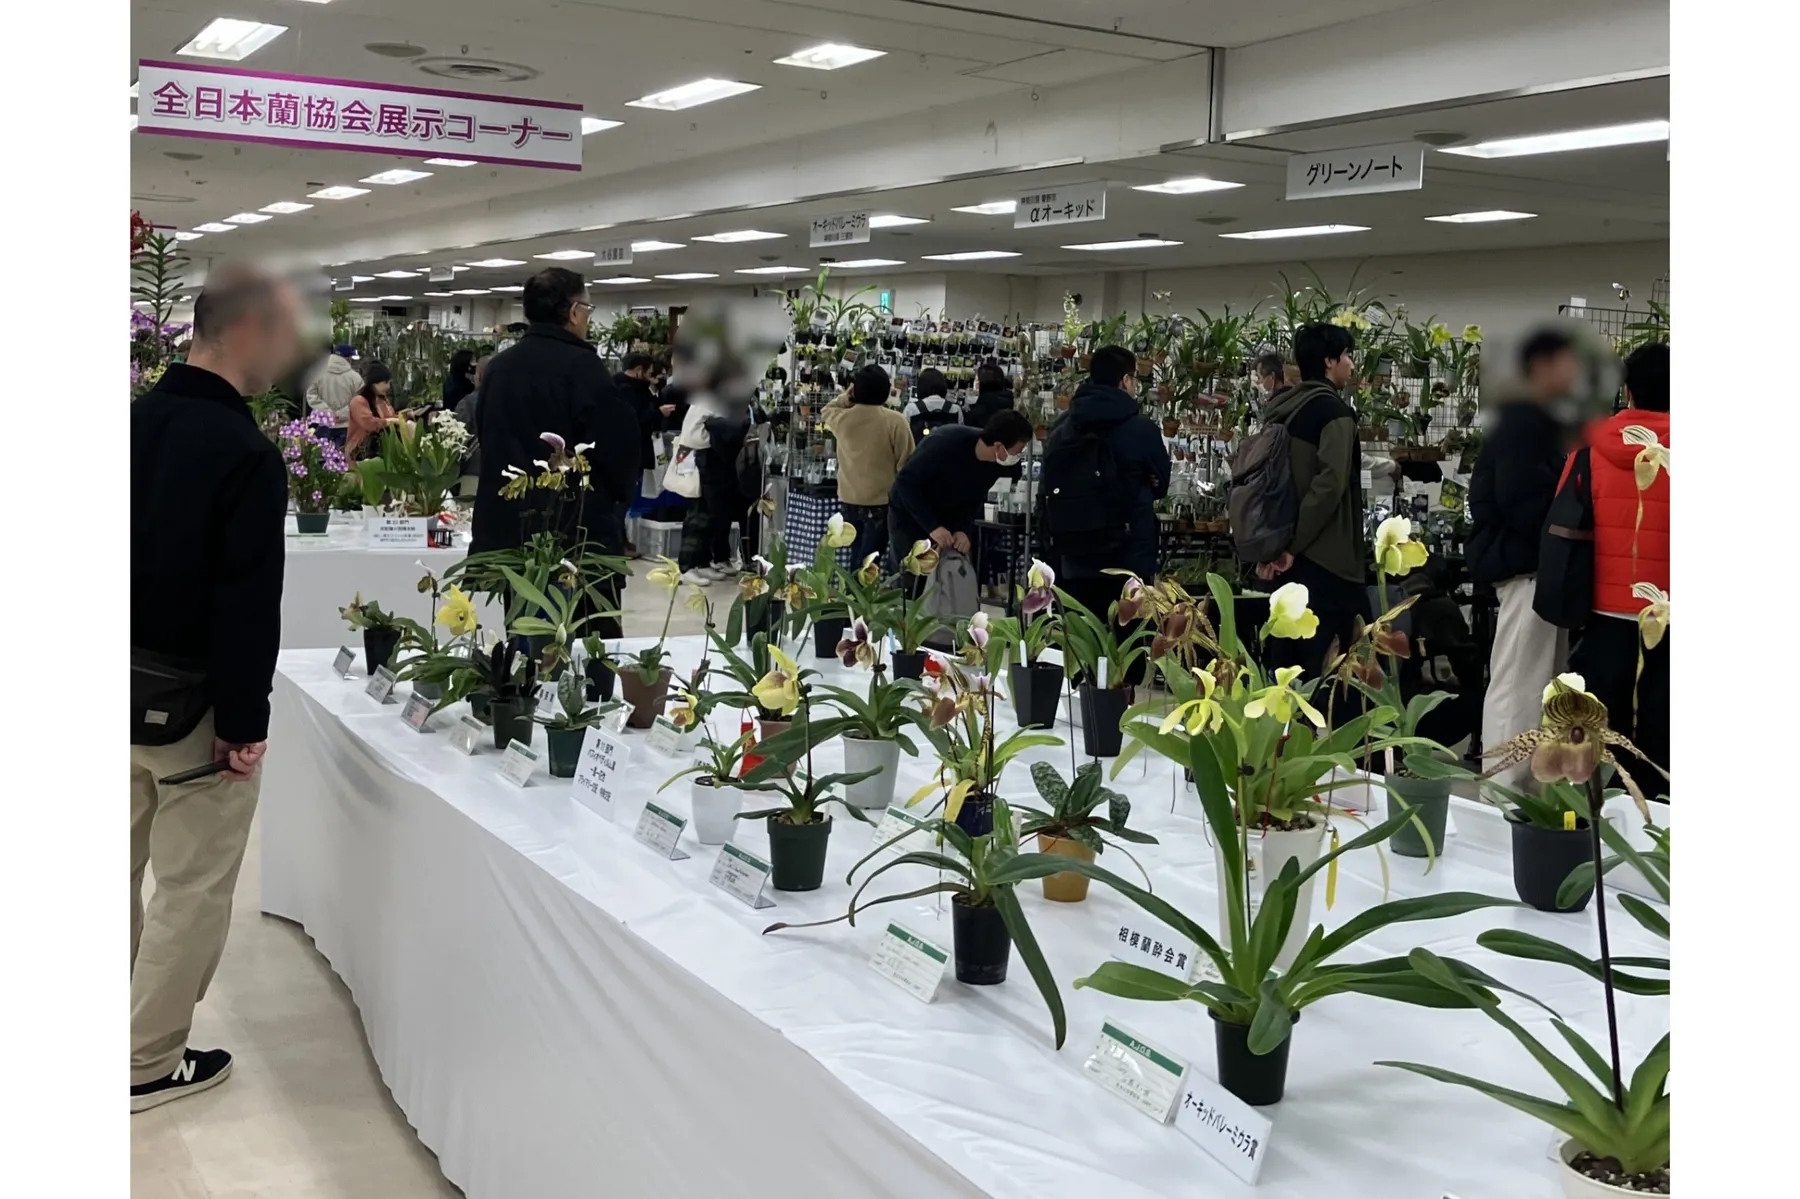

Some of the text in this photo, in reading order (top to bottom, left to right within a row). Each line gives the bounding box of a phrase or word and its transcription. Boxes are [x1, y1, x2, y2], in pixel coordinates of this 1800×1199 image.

[152, 81, 573, 148] 全日本蘭協会展示コーナー
[1306, 155, 1403, 186] グリーンノート
[812, 213, 867, 233] オーキッドバレーミウラ
[1030, 199, 1095, 223] αオーキッド
[1118, 925, 1188, 971] 相模蘭酔会賞
[171, 1059, 197, 1082] N
[1184, 1090, 1259, 1161] オーキッドバレーミウラ賞
